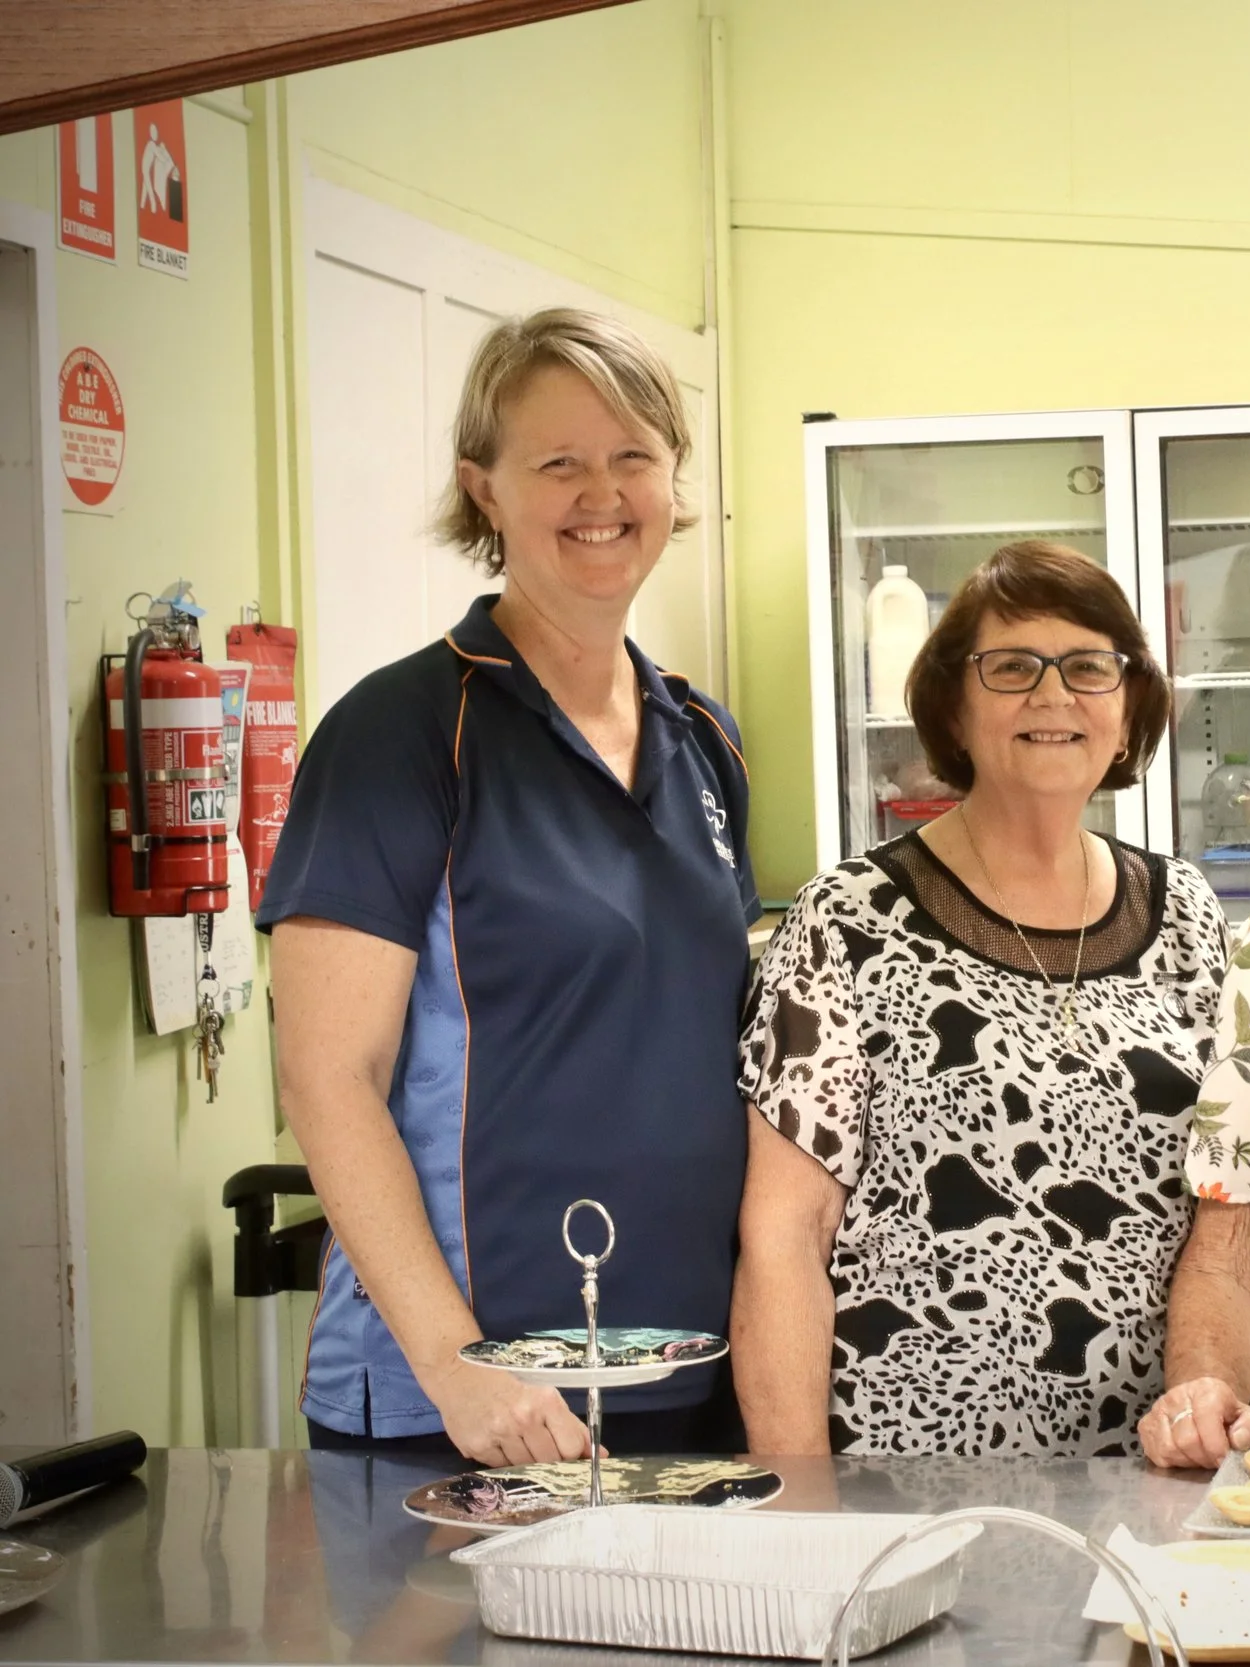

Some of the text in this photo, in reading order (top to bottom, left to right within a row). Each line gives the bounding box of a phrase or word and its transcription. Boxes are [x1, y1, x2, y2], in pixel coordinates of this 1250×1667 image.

[79, 198, 96, 219] FIRE
[62, 217, 113, 248] EXTINGUISHER
[140, 243, 187, 271] FIRE BLANKET
[79, 389, 96, 405] DRY
[67, 403, 109, 425] CHEMICAL
[247, 700, 297, 727] FIRE BLANKE
